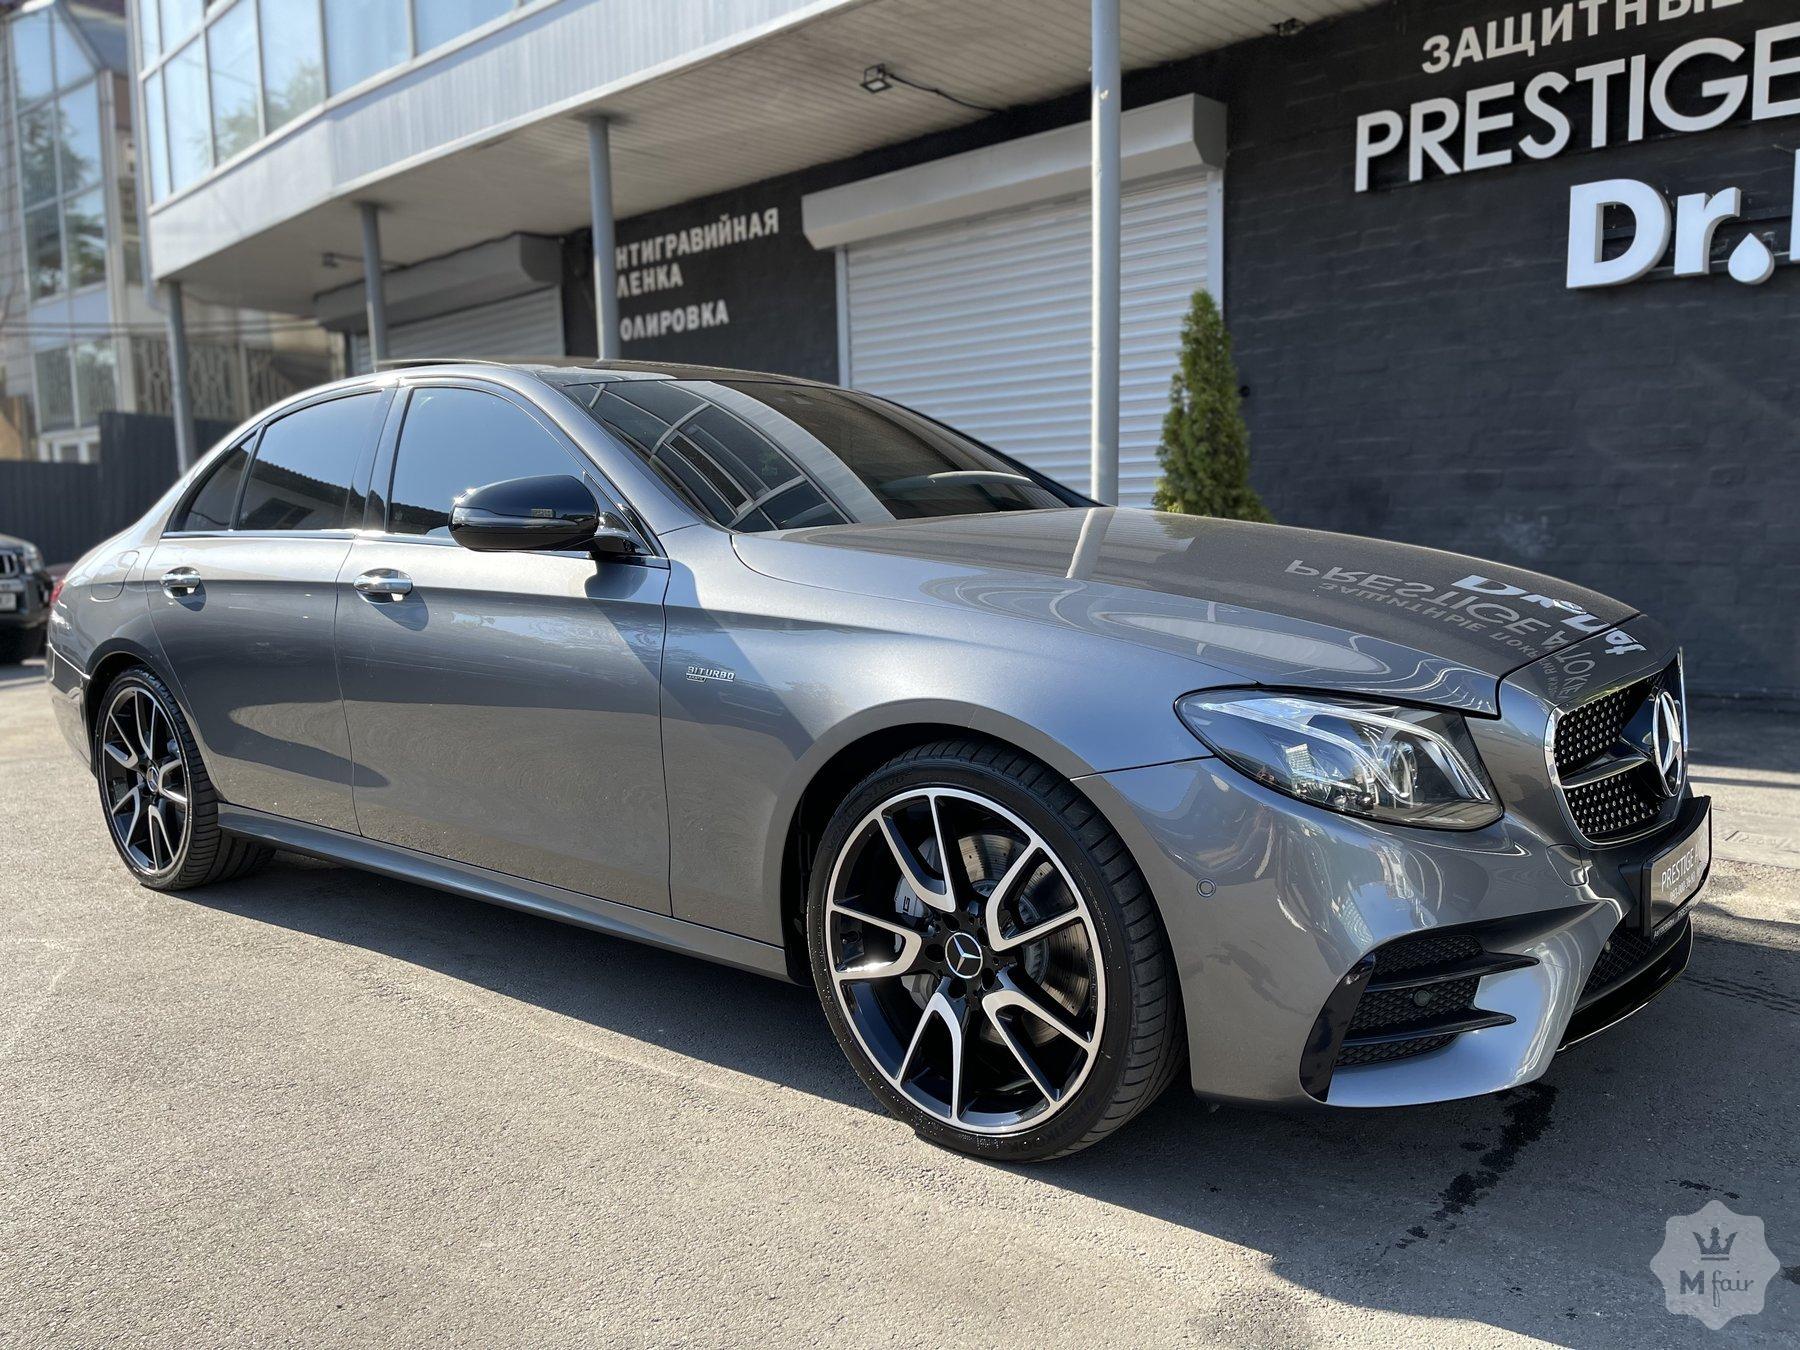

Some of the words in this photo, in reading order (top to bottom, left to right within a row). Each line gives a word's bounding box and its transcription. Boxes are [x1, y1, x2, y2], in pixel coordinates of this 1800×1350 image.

[1422, 0, 1744, 73] ЗАЩИТНЫ
[1355, 22, 1800, 193] PRESTIGE
[615, 207, 779, 270] НТИГРАВИЙНАЯ
[1566, 149, 1800, 289] Dr.
[617, 262, 683, 298] ЛЕНКА
[620, 299, 729, 341] ОЛИРОВКА
[687, 666, 735, 680] BITURBO
